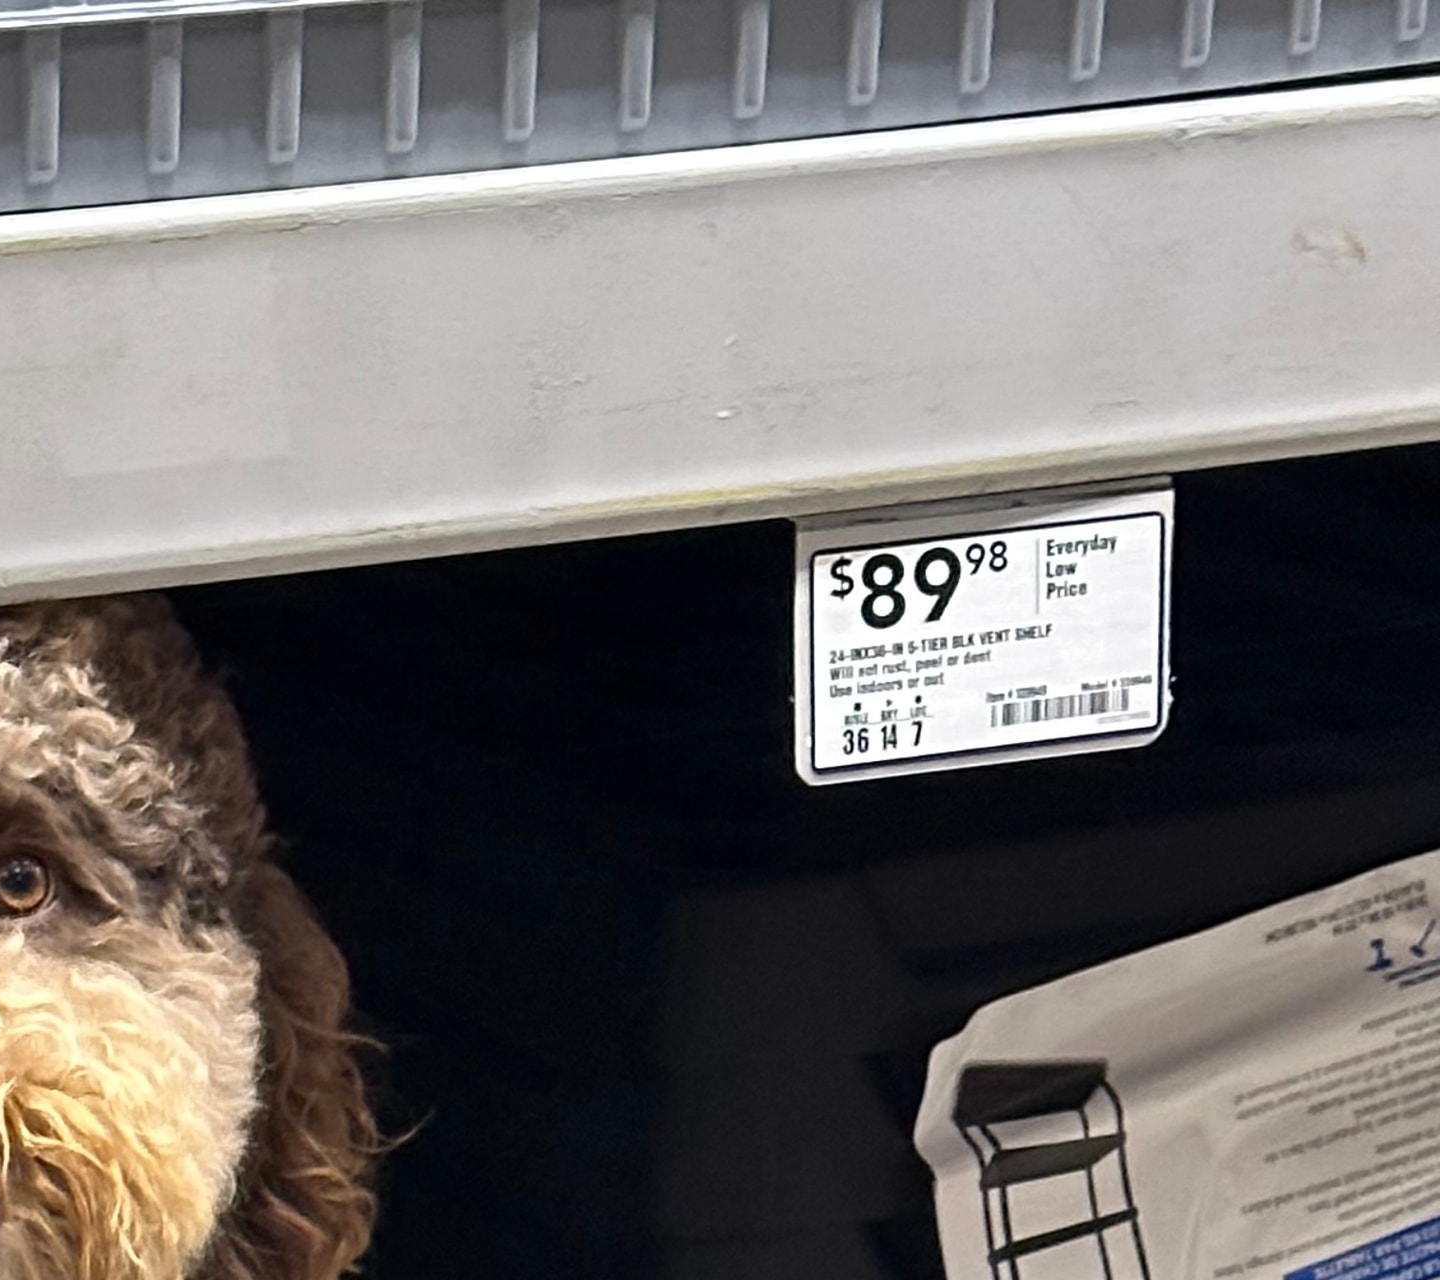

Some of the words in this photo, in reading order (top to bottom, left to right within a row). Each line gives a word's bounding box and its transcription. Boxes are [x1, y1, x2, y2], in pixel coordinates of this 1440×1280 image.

[1045, 534, 1118, 557] Everyday
[1045, 560, 1078, 579] Low
[1045, 579, 1089, 600] Price
[978, 628, 1011, 646] VENT
[842, 728, 870, 756] 36
[881, 723, 898, 751] 14
[911, 720, 924, 746] 7
